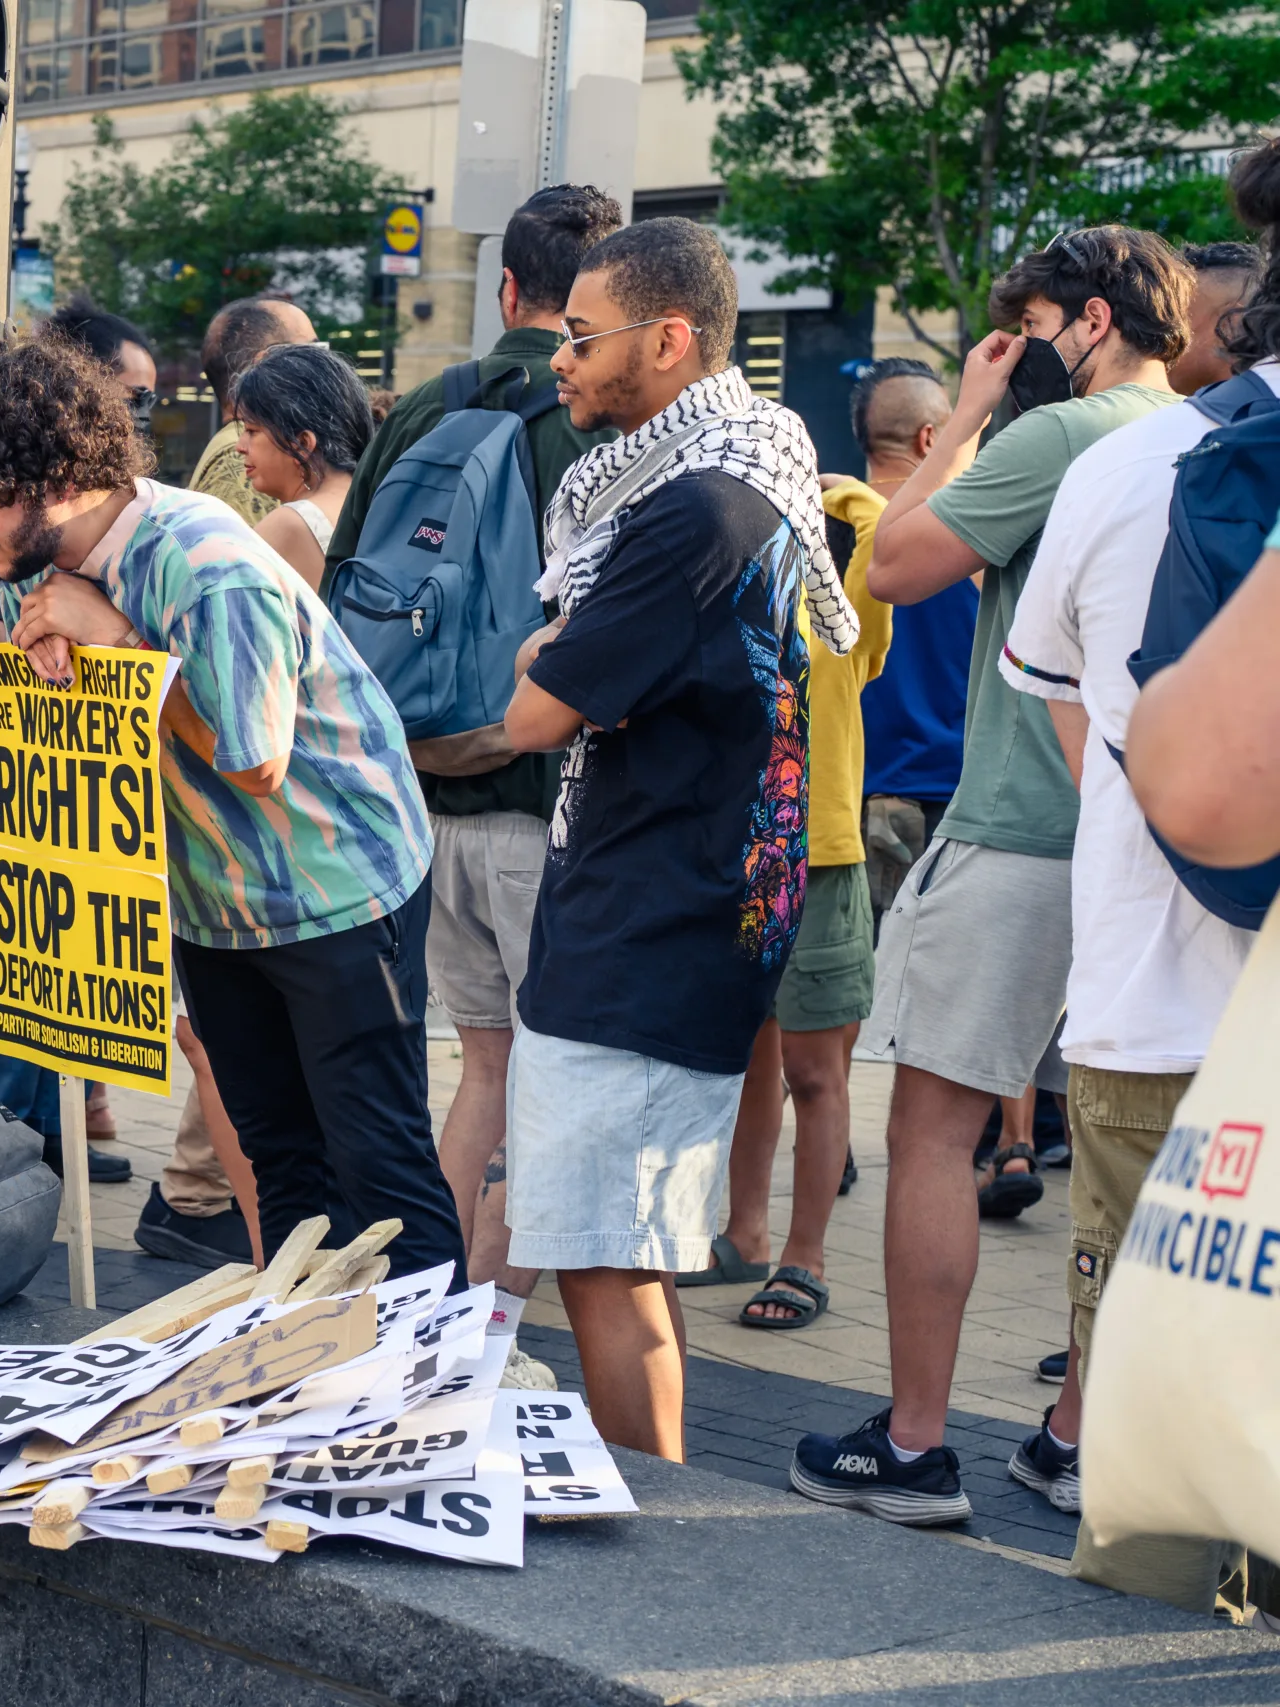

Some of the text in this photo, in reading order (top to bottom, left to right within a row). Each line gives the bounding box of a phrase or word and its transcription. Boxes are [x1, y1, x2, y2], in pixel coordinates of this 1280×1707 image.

[79, 656, 155, 701] RIGHTS
[15, 692, 151, 760] WORKER'S
[87, 891, 164, 976] THE
[26, 1020, 41, 1042] FOR
[41, 1024, 89, 1056] SOCIALISM
[91, 1037, 100, 1058] &
[101, 1038, 163, 1071] LIBERATION
[832, 1453, 879, 1476] HOKA
[282, 1490, 492, 1538] STOP
